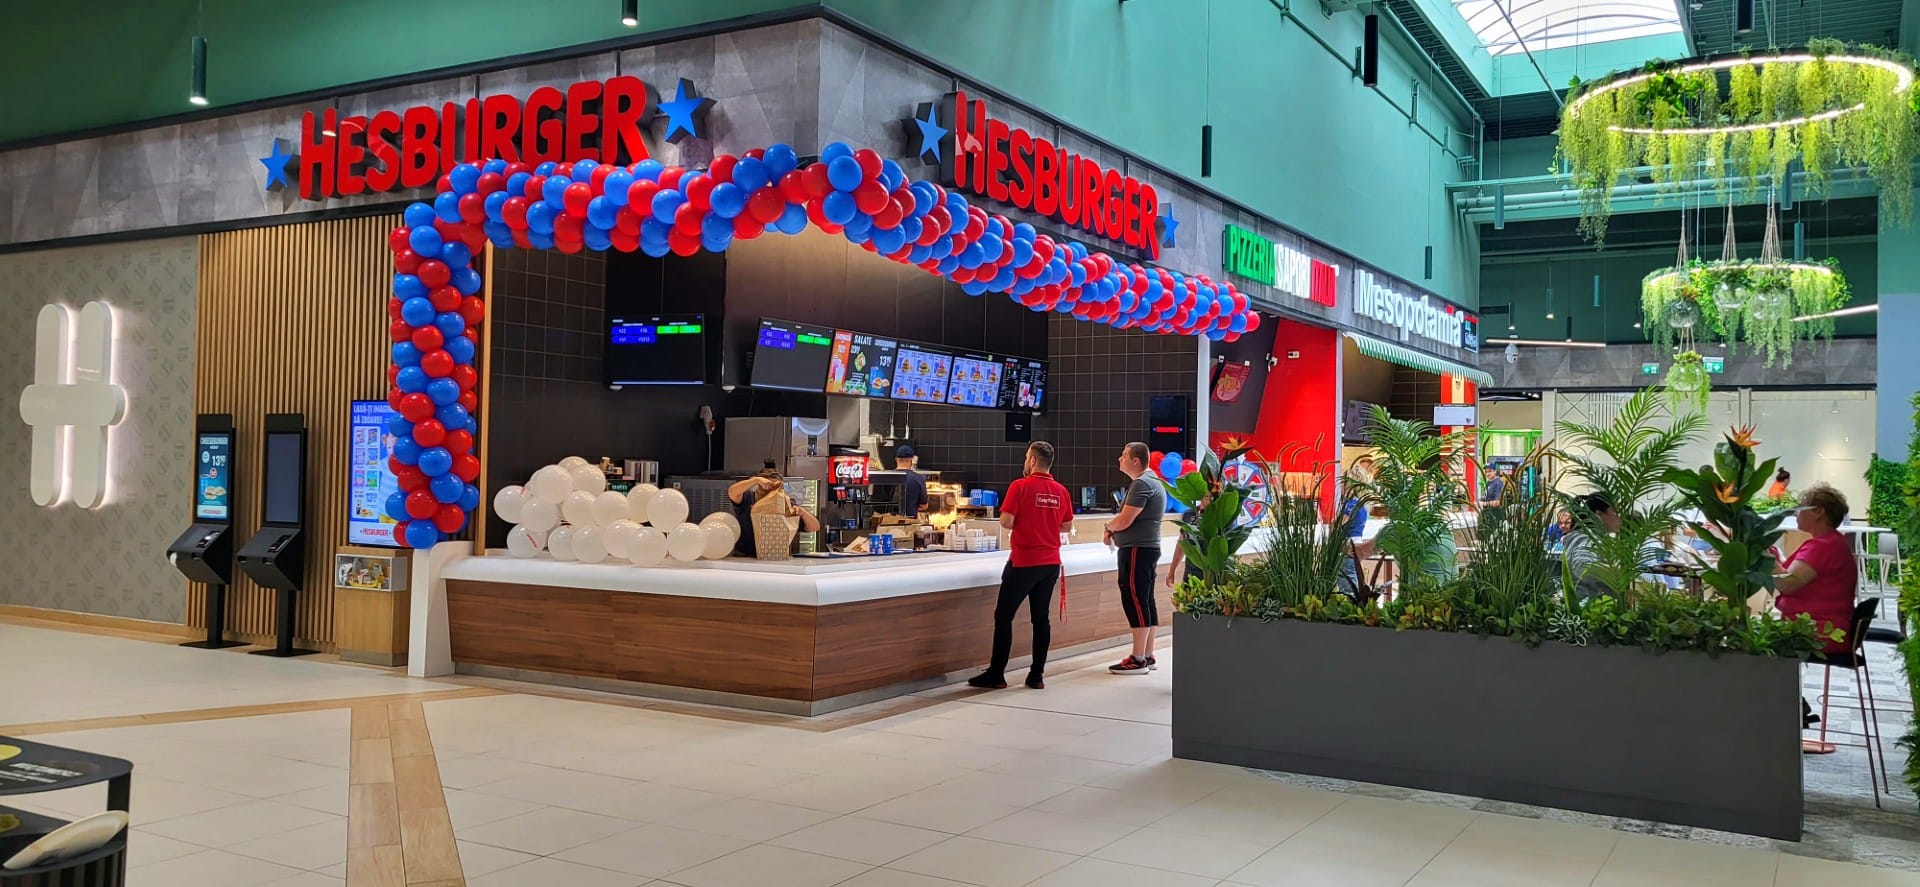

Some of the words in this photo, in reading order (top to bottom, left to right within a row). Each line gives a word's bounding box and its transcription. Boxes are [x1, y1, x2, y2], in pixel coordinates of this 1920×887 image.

[301, 76, 651, 200] HESBURGER
[954, 90, 1160, 261] HESBURGER
[1226, 224, 1276, 287] PIZZERIA
[1273, 244, 1310, 299] SAPORI
[853, 334, 873, 346] SALATE
[1354, 268, 1462, 347] Mesopotamia
